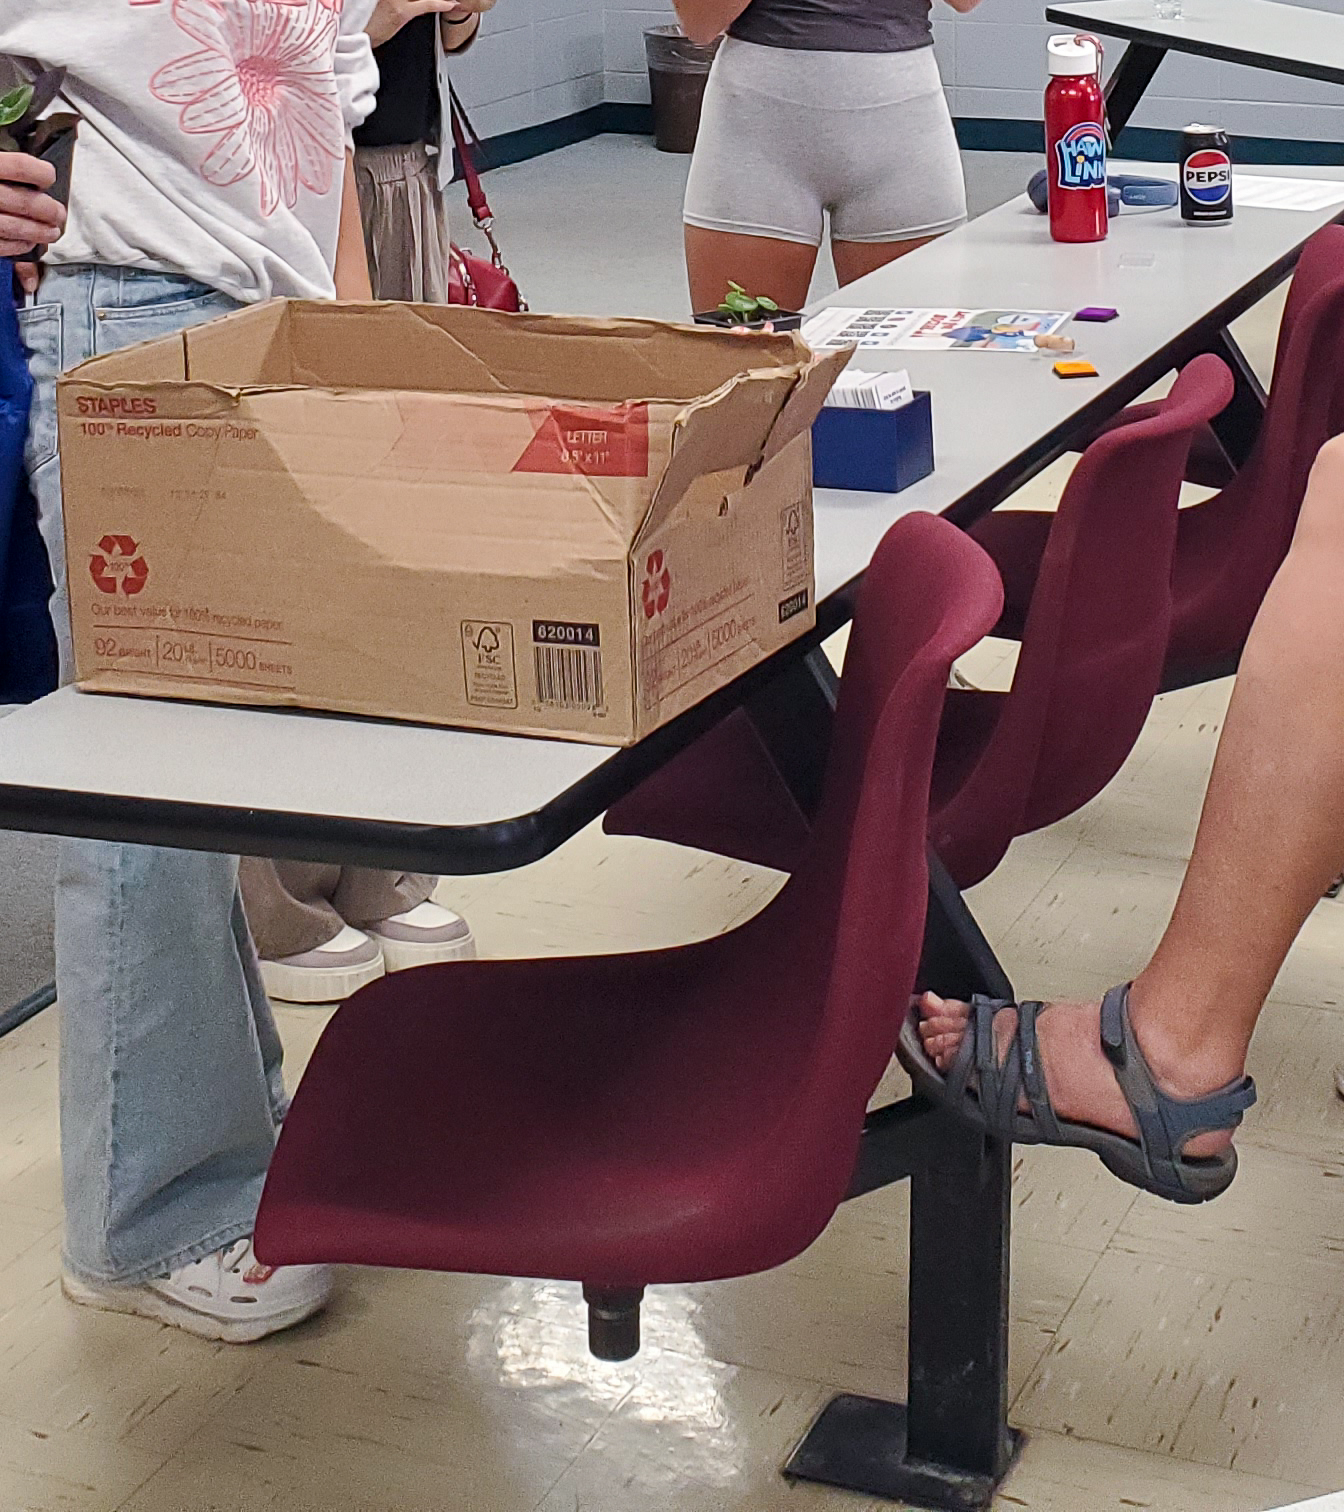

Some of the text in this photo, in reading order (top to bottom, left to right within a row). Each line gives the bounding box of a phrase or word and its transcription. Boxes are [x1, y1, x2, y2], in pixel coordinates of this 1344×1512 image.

[1060, 139, 1106, 158] HAW
[1186, 169, 1230, 183] PEPSI
[76, 395, 157, 415] STAPLES
[117, 422, 181, 440] Recycled
[186, 423, 222, 440] Copy
[224, 425, 259, 440] Paper
[91, 603, 111, 616] Our
[255, 618, 283, 630] paper
[537, 624, 594, 642] 620014
[94, 638, 117, 656] 92
[162, 641, 184, 663] 20
[215, 647, 256, 671] 5000
